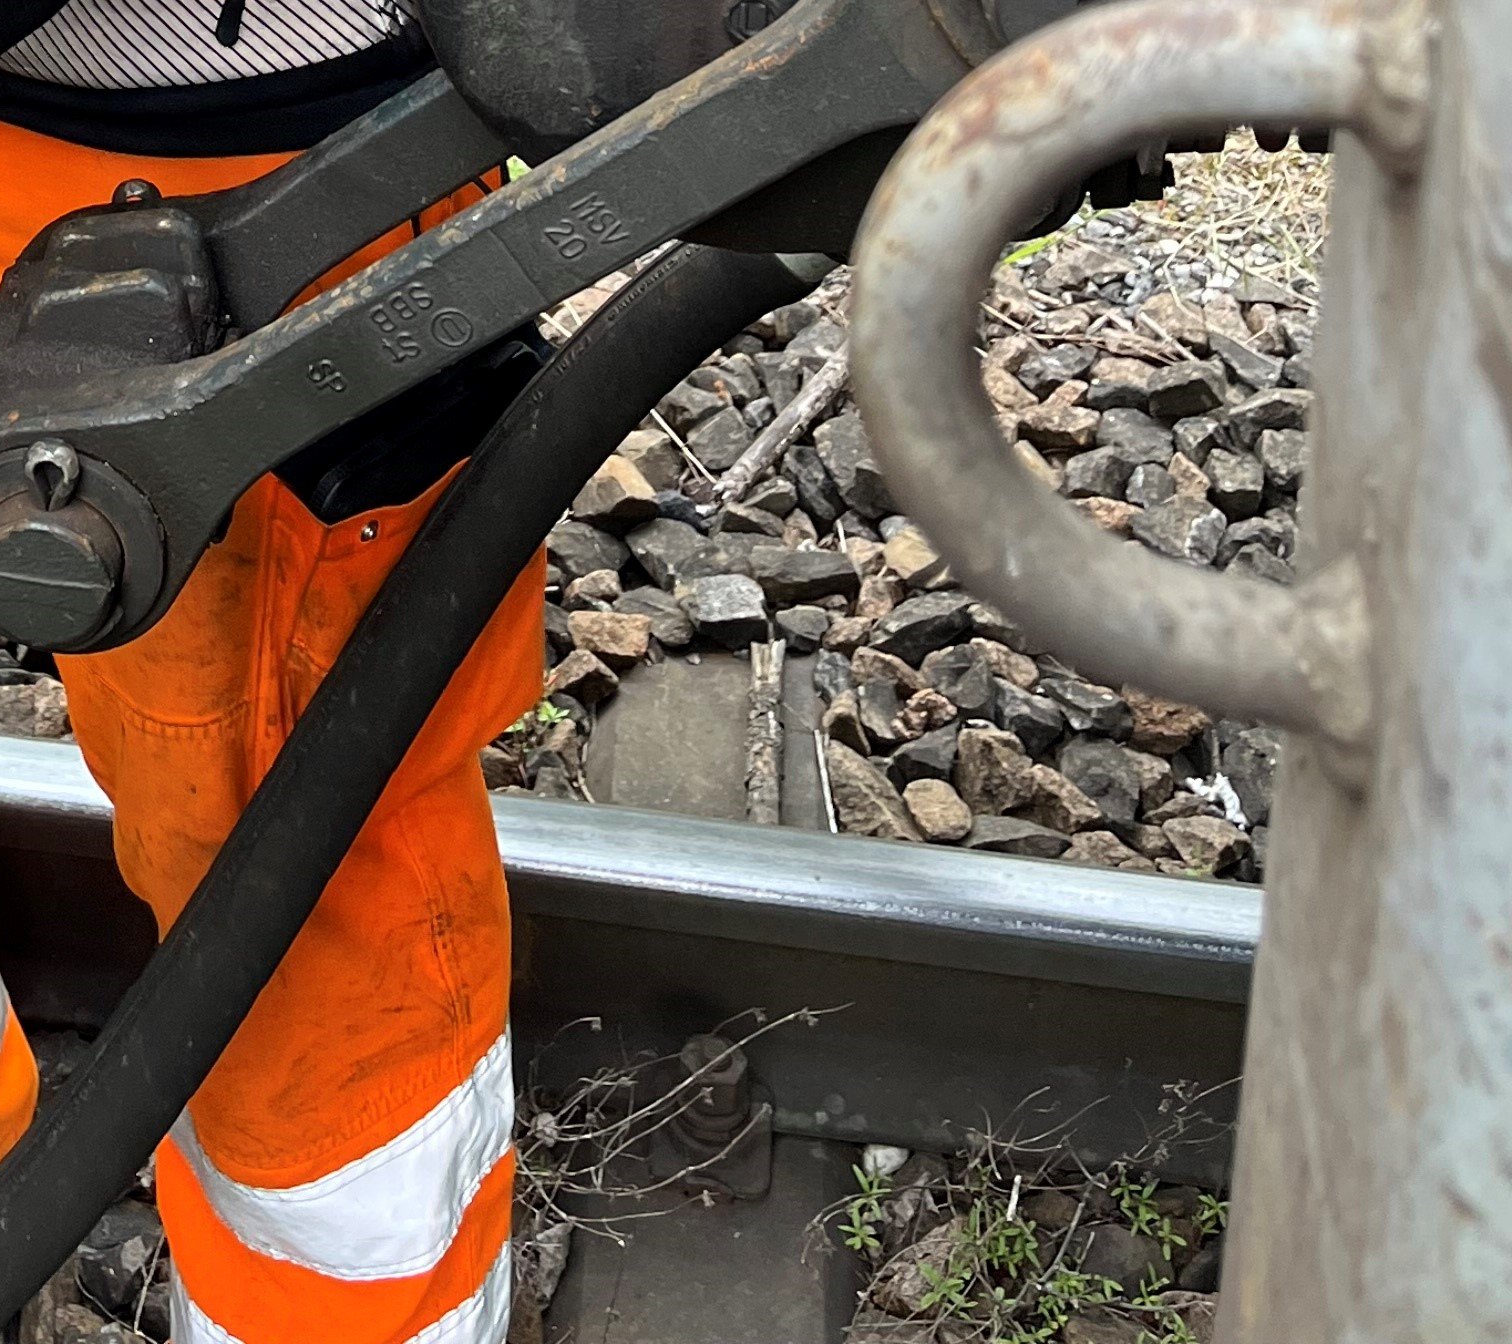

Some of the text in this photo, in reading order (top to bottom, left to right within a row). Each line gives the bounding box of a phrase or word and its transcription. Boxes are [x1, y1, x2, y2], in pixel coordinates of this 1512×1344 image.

[545, 219, 587, 260] 20
[570, 191, 631, 245] MSV
[370, 281, 434, 334] SBB
